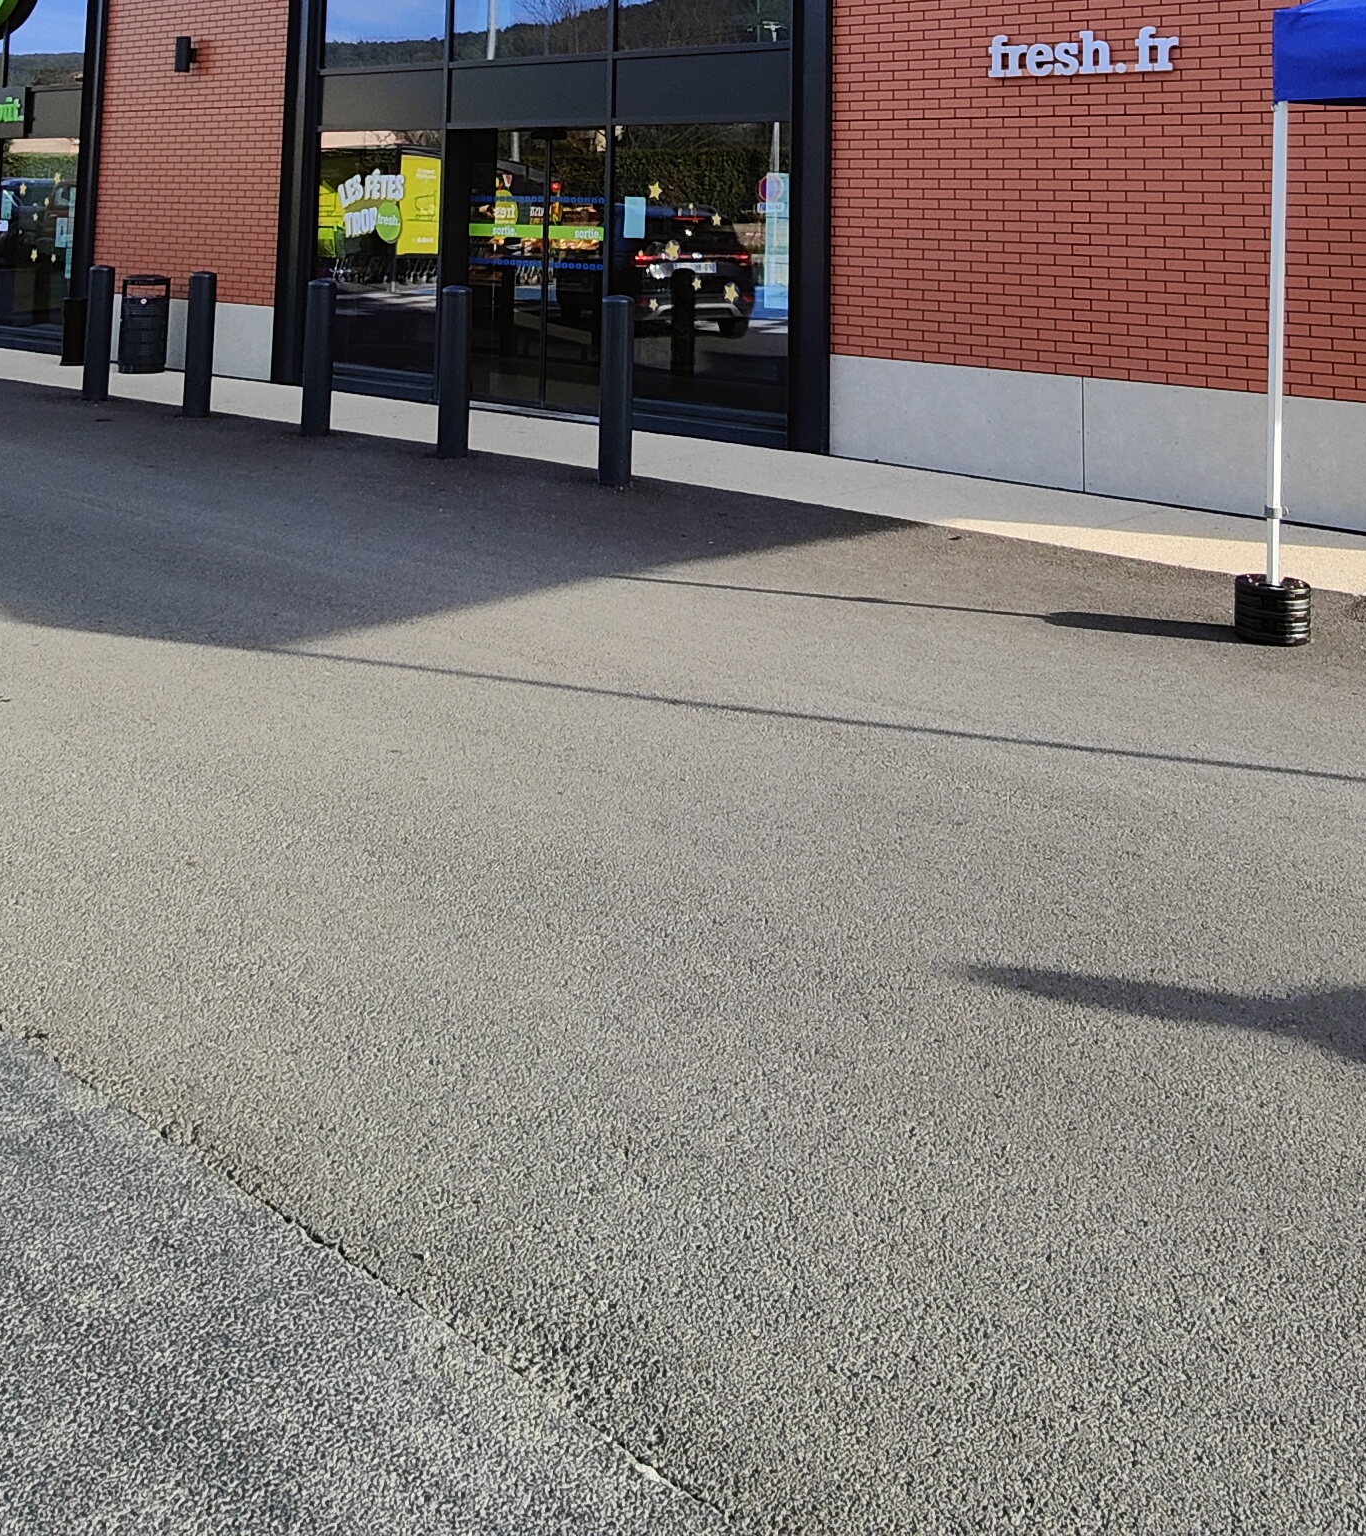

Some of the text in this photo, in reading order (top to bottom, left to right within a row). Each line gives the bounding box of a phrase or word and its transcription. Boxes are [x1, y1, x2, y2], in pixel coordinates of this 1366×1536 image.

[988, 26, 1179, 78] fresh.fr
[337, 168, 404, 208] LES FÊTES
[344, 207, 377, 238] TROP
[492, 225, 517, 237] sortie.
[575, 228, 603, 240] sortie.
